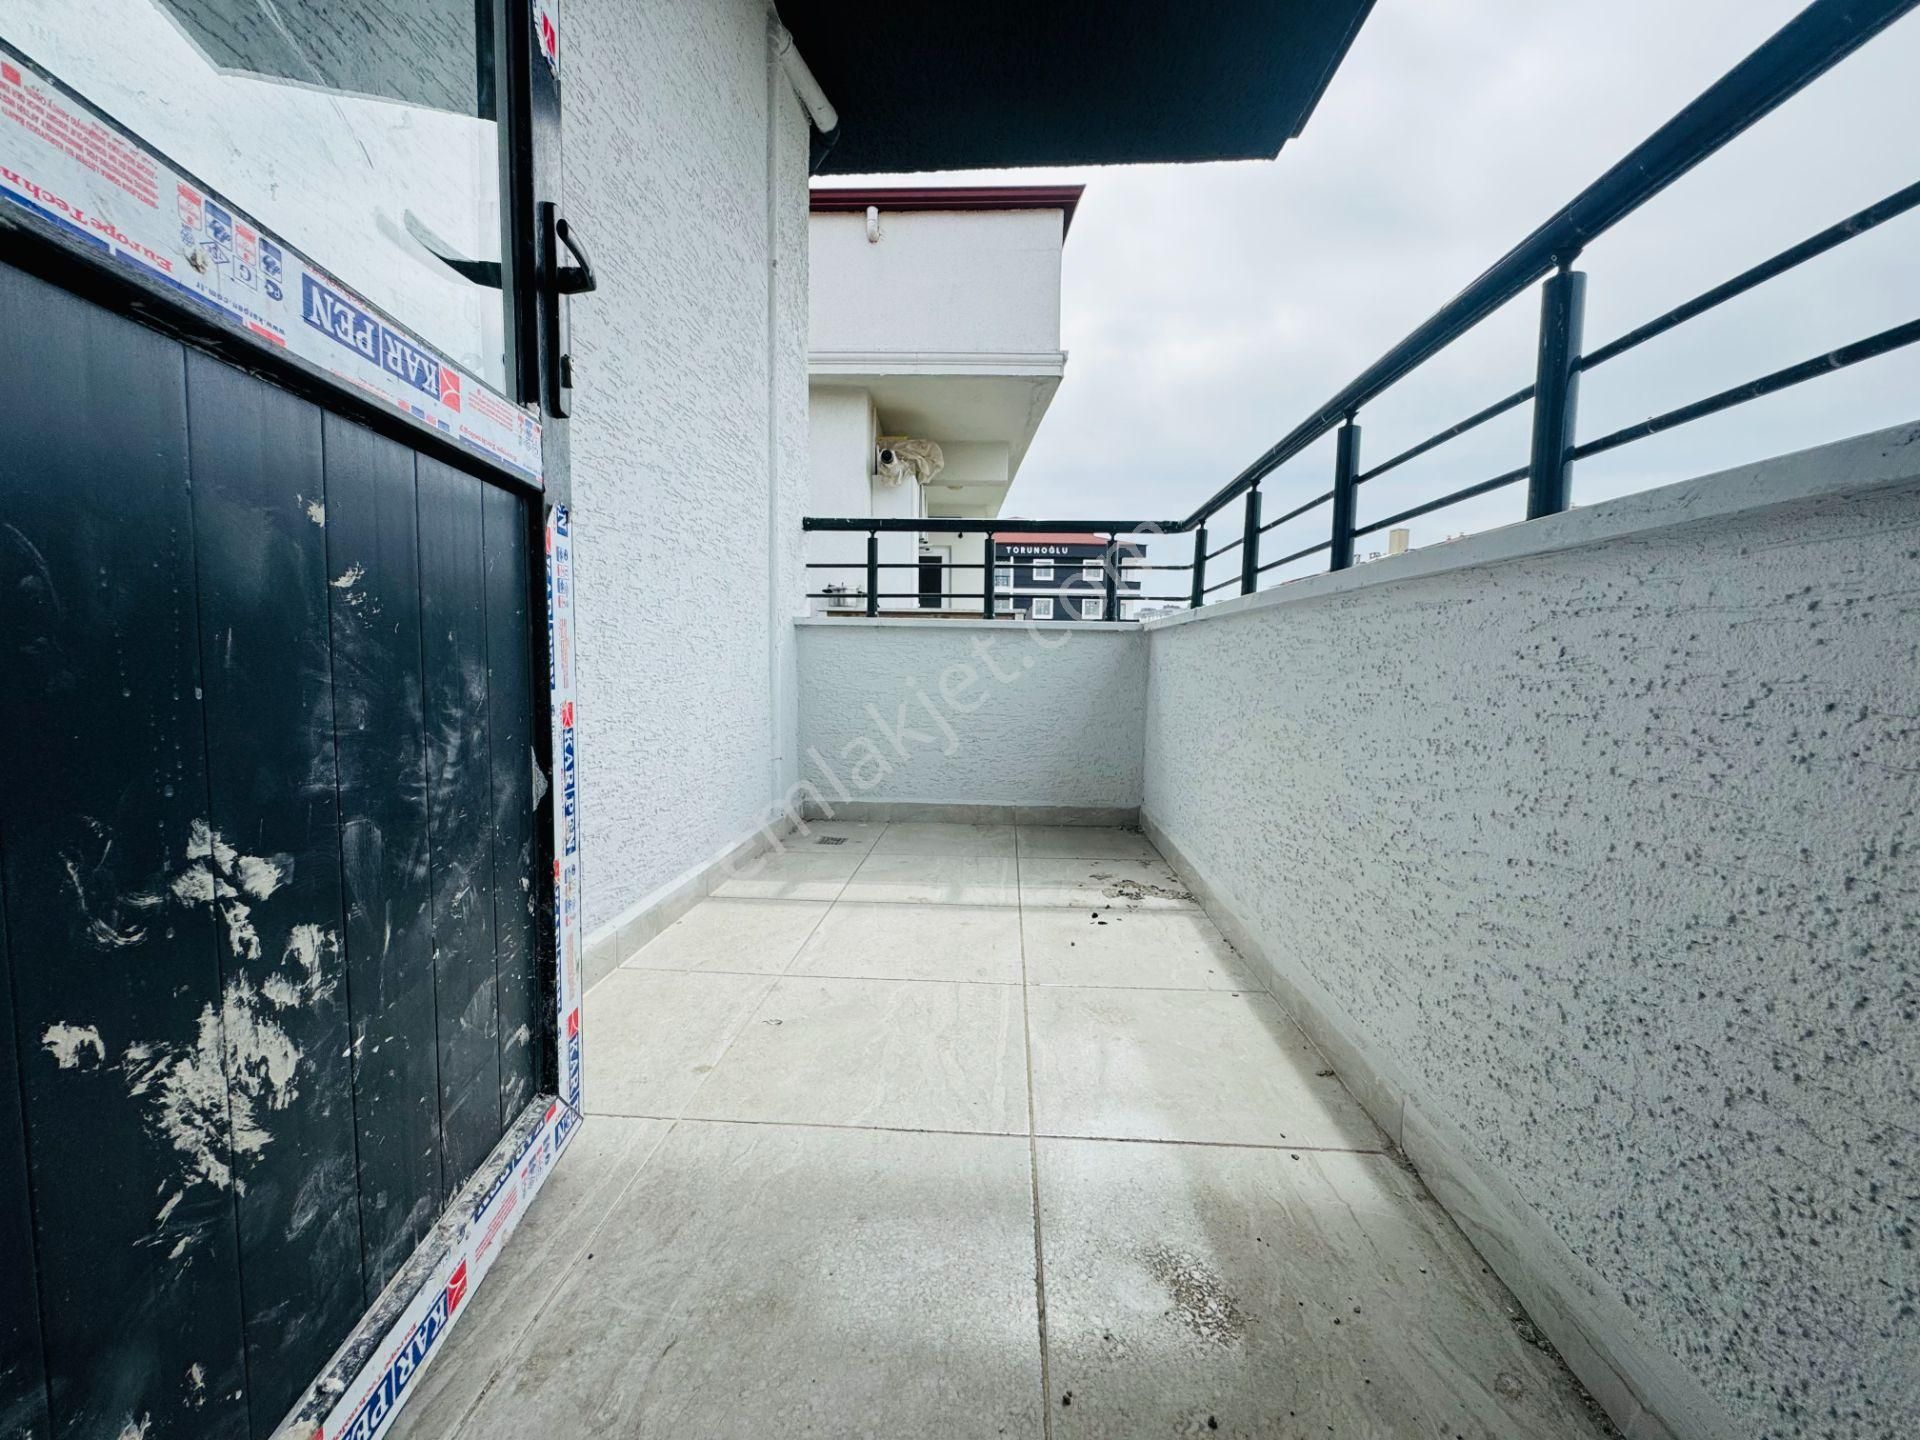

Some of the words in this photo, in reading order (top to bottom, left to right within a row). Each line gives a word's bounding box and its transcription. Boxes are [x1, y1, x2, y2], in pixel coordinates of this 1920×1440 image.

[90, 216, 174, 273] Europe
[310, 284, 377, 359] PEN
[384, 333, 440, 397] KAR
[563, 728, 575, 788] KAR
[569, 1036, 580, 1094] KAR
[397, 1289, 448, 1387] KAR
[343, 1380, 390, 1440] PE
